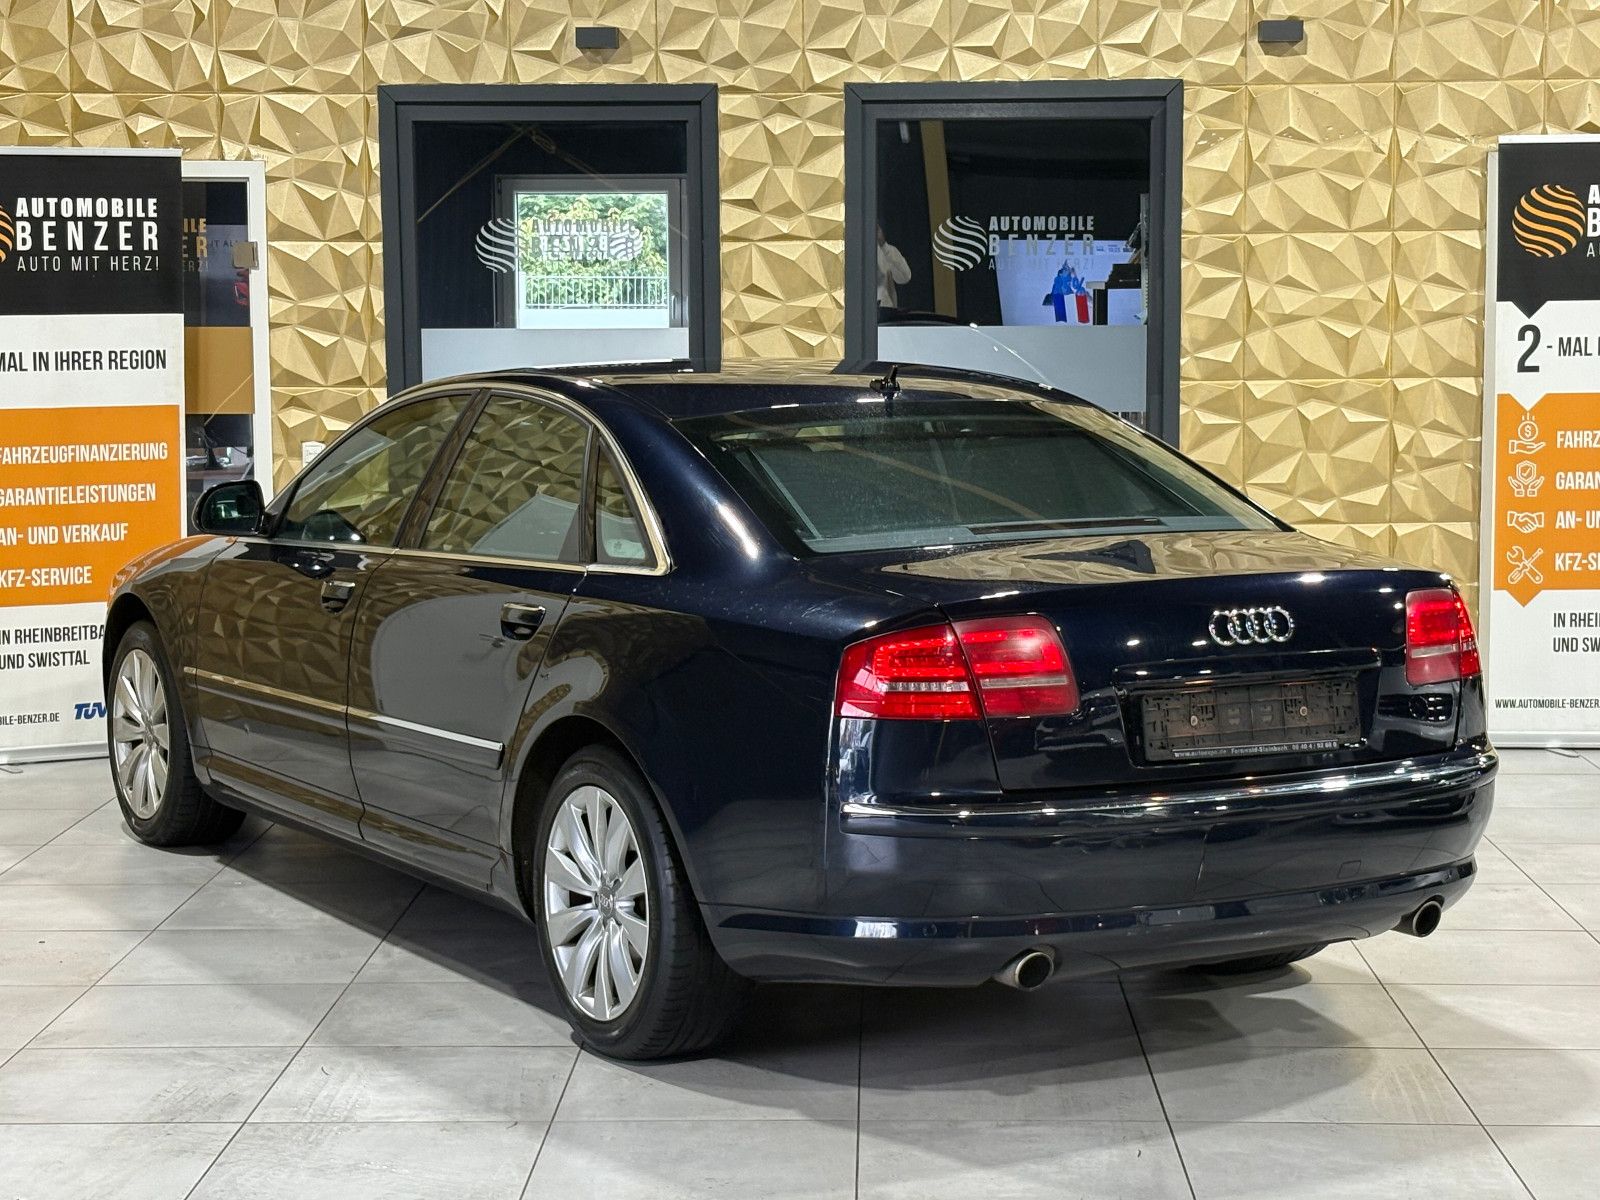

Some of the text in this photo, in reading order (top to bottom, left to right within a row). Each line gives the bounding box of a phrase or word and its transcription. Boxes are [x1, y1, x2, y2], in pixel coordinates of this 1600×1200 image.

[16, 197, 158, 218] AUTOMOBILE
[989, 215, 1094, 232] AUTOMOBILE
[16, 220, 159, 251] BENZER
[988, 233, 1095, 256] BENZER
[17, 255, 160, 272] AUTO MIT HERZ!
[1517, 324, 1541, 373] 2
[1558, 336, 1593, 356] MAL
[33, 351, 49, 371] IN
[54, 351, 103, 371] IHRER
[108, 350, 167, 370] REGION
[1555, 510, 1582, 529] AN-
[0, 522, 129, 546] AN- UND VERKAUF
[0, 565, 93, 588] KFZ-SERVICE
[1553, 612, 1600, 628] IN RHEI
[1553, 637, 1578, 653] UND
[0, 650, 90, 670] UND SWISTTAL
